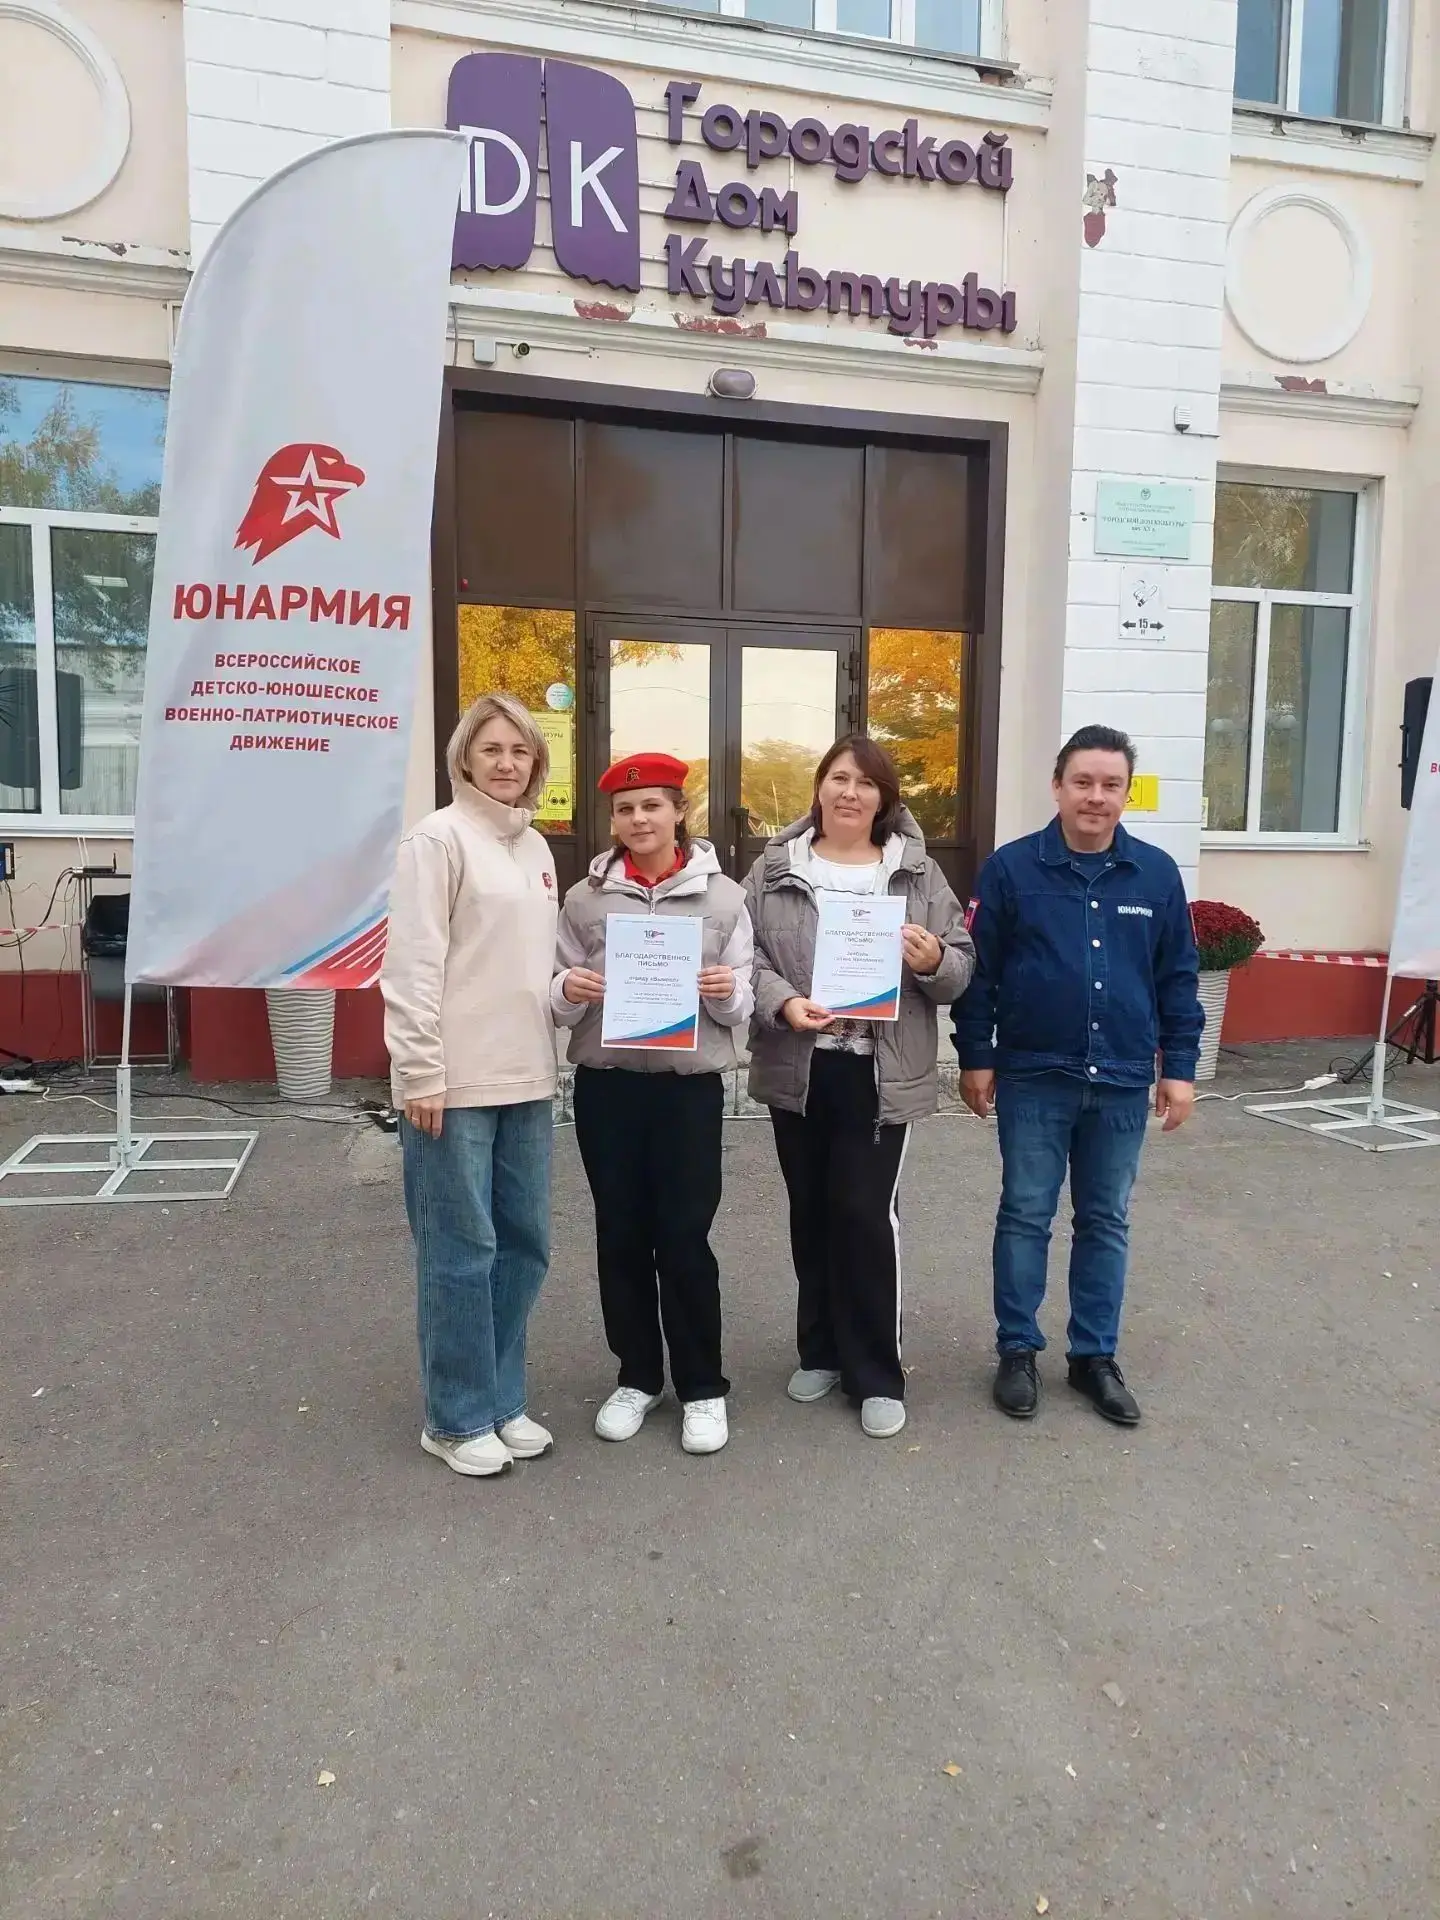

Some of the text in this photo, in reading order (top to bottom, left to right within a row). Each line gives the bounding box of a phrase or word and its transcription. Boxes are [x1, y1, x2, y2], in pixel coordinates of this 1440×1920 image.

[664, 80, 1015, 192] Городской
[664, 159, 799, 236] Дом
[664, 232, 1018, 338] Культуры
[173, 583, 412, 630] ЮНАРМИЯ
[1139, 618, 1148, 629] 15
[214, 653, 361, 674] ВСЕРОССИЙСКОЕ
[190, 680, 379, 703] ДЕТСКО-ЮНОШЕСКОЕ
[164, 707, 399, 730] ВОЕННО-ПАТРИОТИЧЕСКОЕ
[229, 735, 330, 753] ДВИЖЕНИЕ
[615, 953, 691, 961] БЛАГОДАРСТВЕННОЕ
